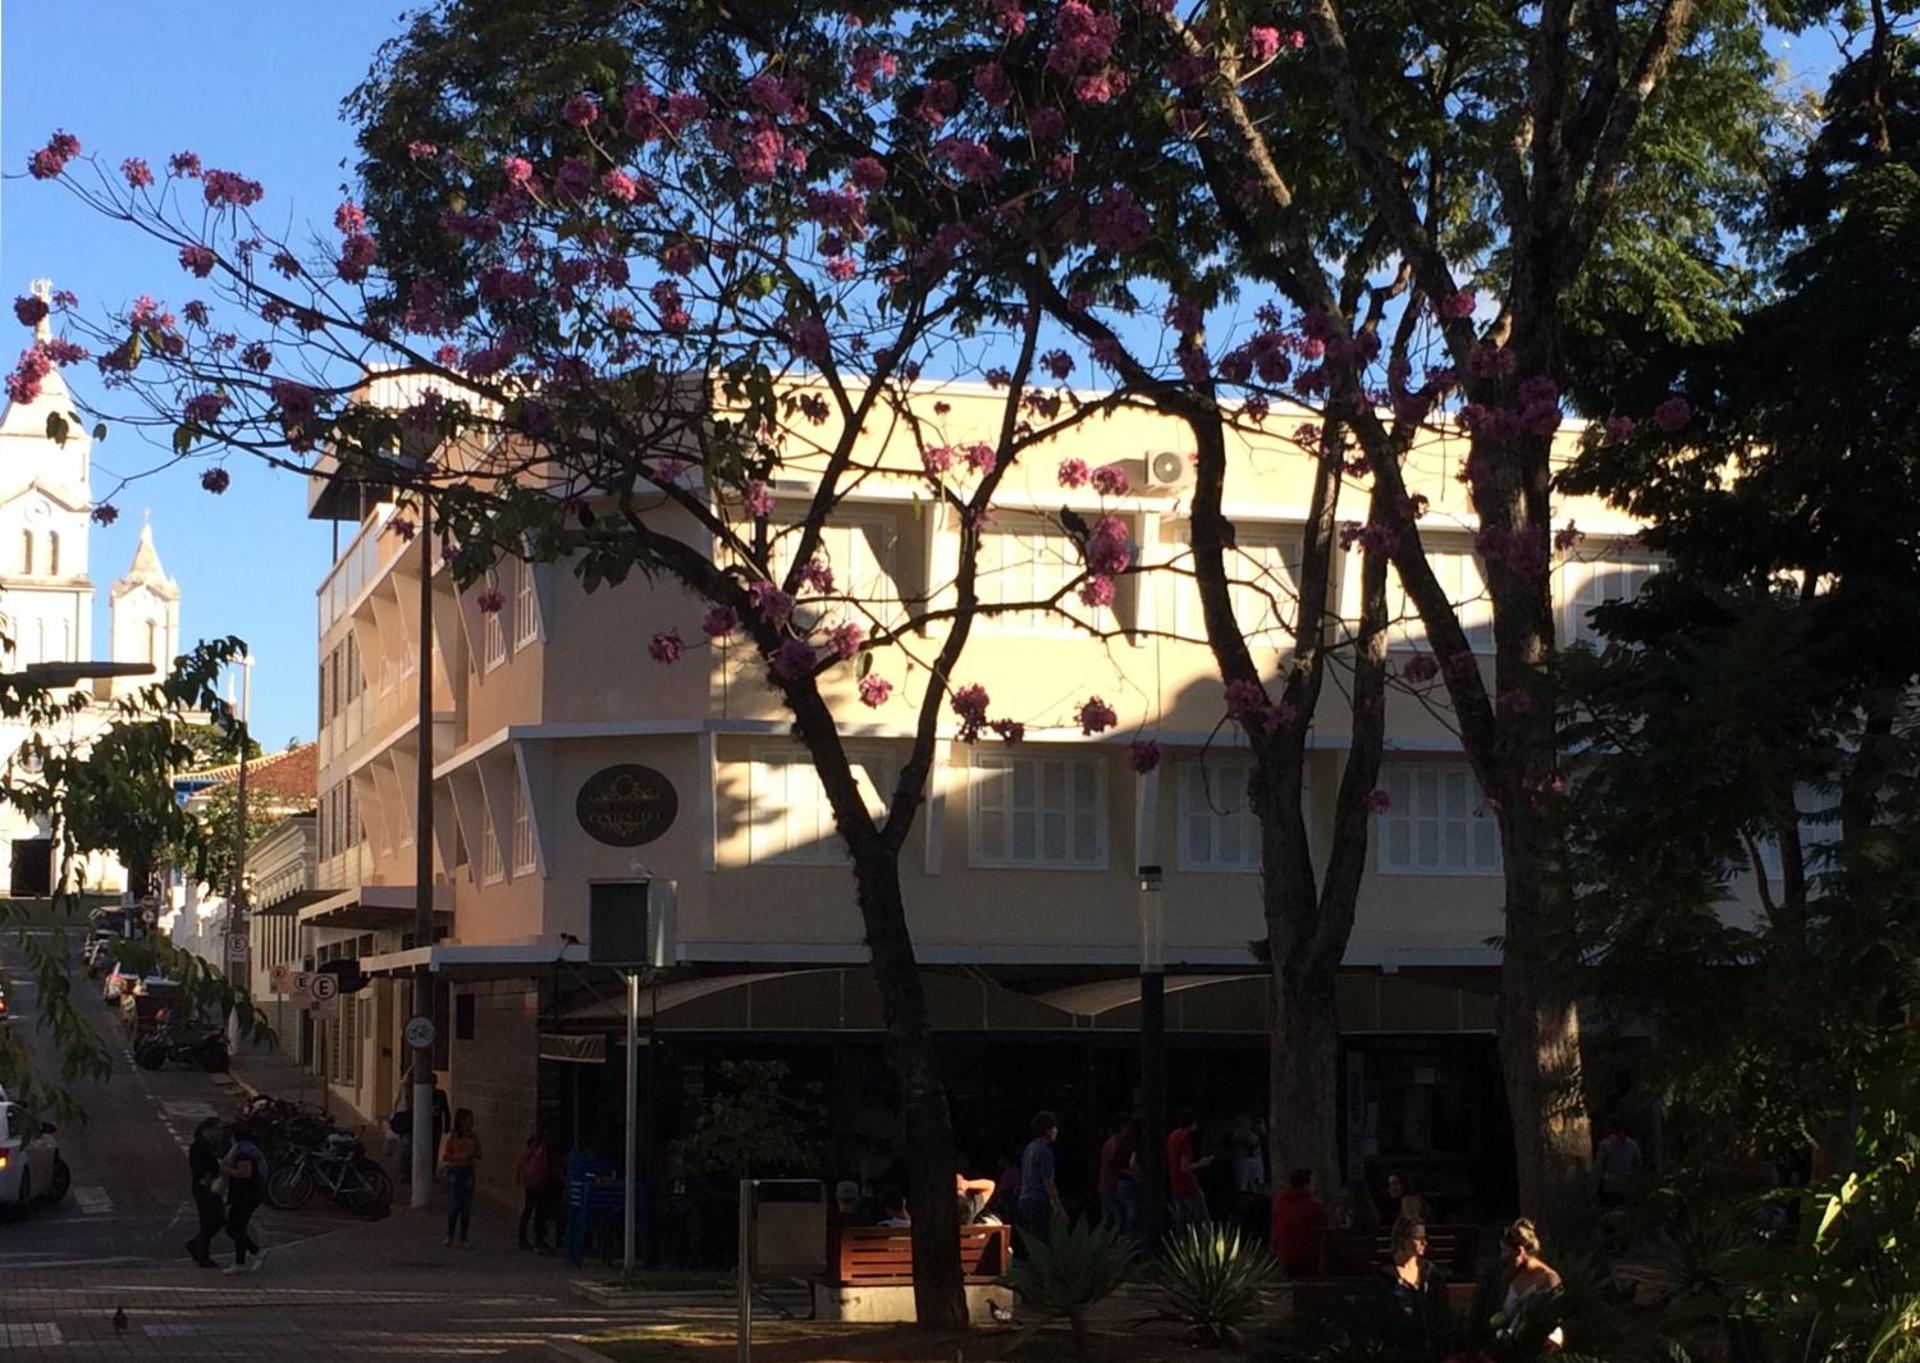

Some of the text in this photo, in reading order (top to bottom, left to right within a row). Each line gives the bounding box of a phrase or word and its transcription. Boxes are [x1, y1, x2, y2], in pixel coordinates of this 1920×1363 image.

[235, 938, 241, 949] E
[299, 977, 307, 988] E
[320, 980, 328, 996] E
